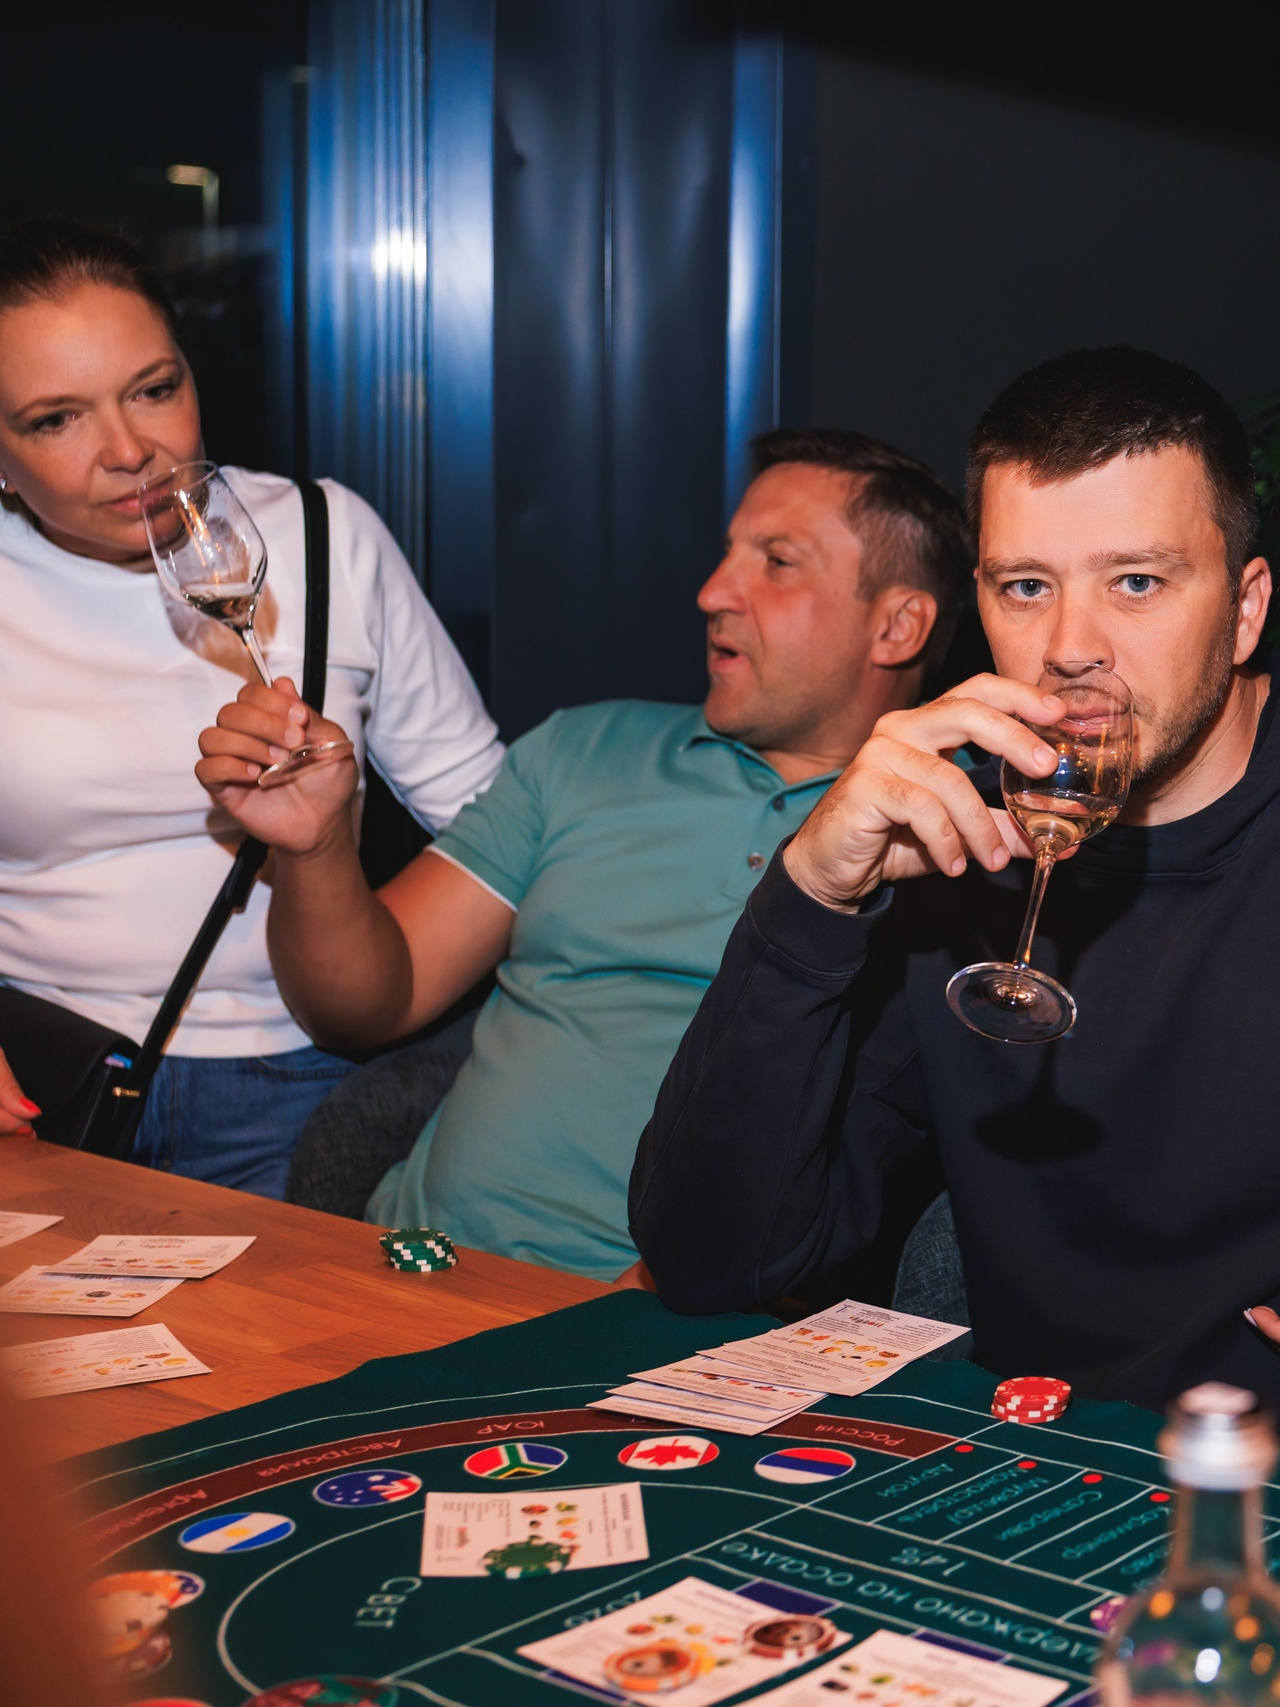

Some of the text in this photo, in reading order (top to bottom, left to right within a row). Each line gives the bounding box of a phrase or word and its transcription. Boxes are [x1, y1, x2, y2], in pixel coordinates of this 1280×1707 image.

[477, 1420, 545, 1435] ЮАР
[813, 1423, 906, 1447] Россия
[256, 1438, 402, 1478] Австралия
[80, 1488, 207, 1546] Аргентин
[890, 1546, 968, 1577] 14%
[353, 1576, 423, 1629] СВЕТ
[720, 1541, 1101, 1664] держано на осадке
